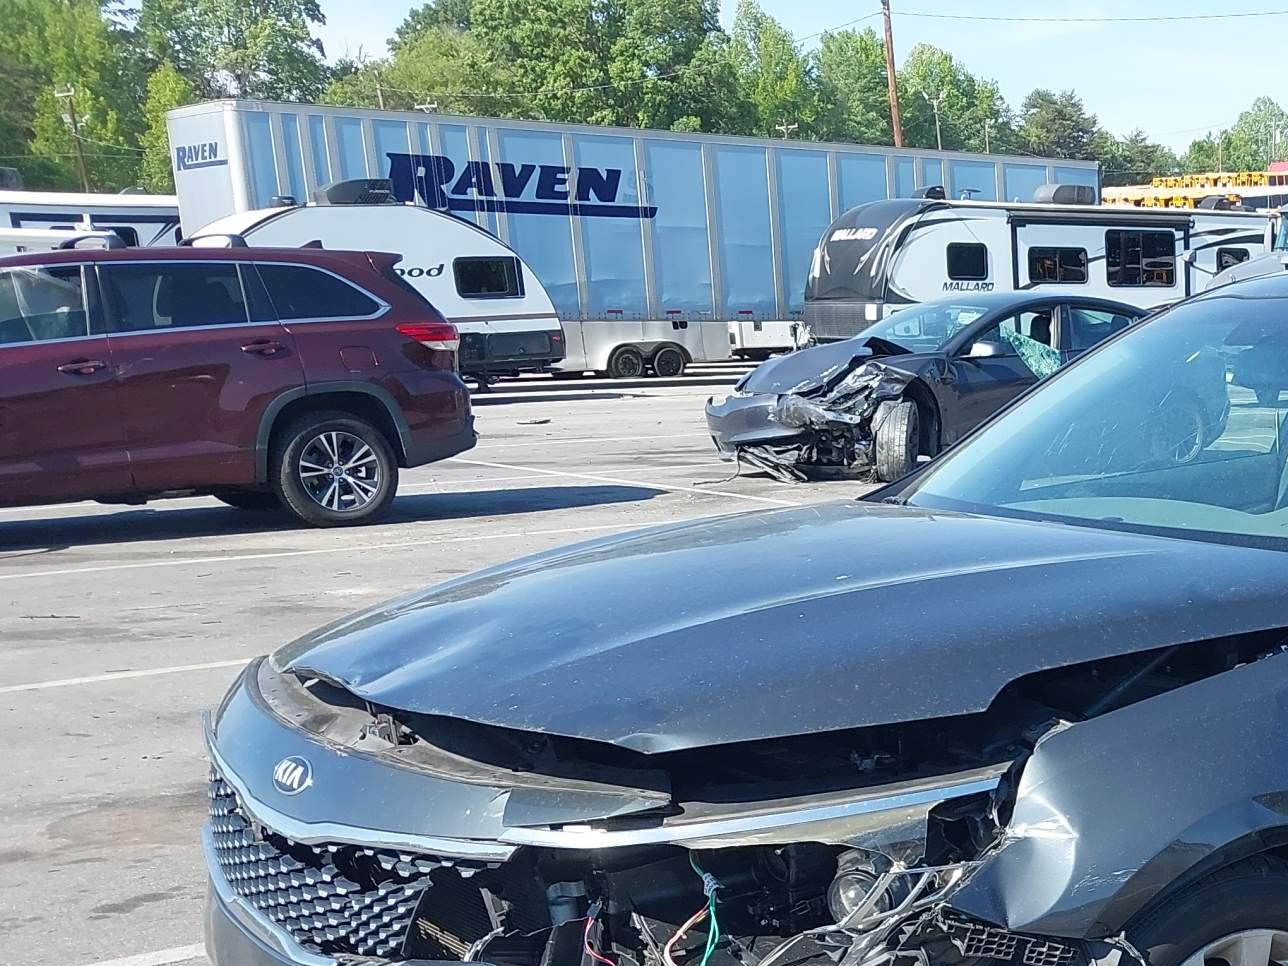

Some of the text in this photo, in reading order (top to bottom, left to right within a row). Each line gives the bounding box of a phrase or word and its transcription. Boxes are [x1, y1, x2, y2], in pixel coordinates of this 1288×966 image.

[176, 141, 218, 171] RAVEN
[386, 152, 621, 208] RAVEN
[830, 227, 879, 242] MALLARD
[942, 281, 994, 292] MALLARD
[274, 759, 304, 789] KIA
